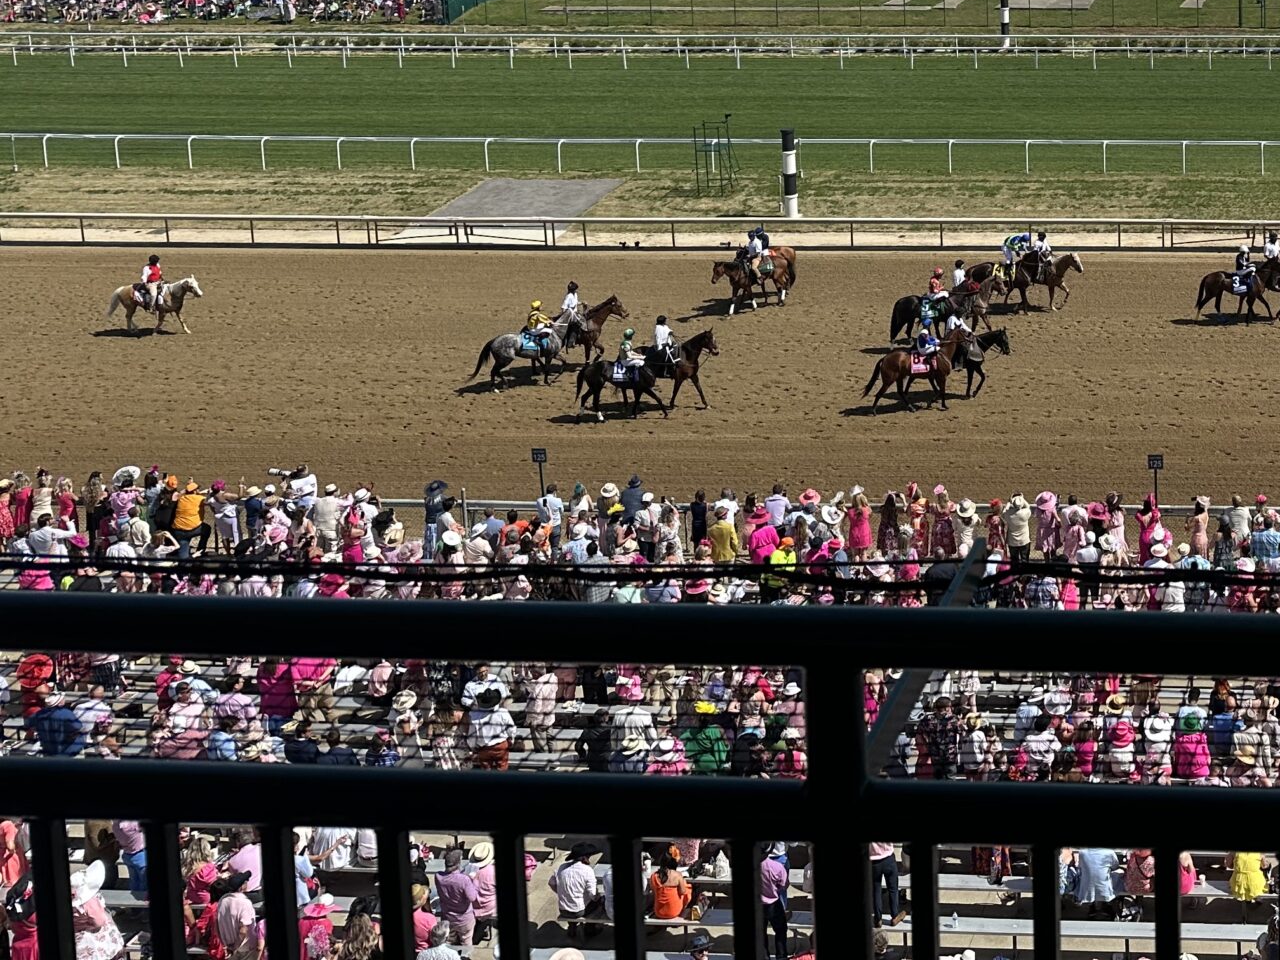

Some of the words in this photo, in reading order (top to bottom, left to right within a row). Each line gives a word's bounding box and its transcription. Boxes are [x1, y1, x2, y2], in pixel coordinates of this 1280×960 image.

[1233, 276, 1240, 287] 3
[921, 300, 929, 311] 5
[913, 352, 920, 364] 8
[614, 361, 626, 373] 10
